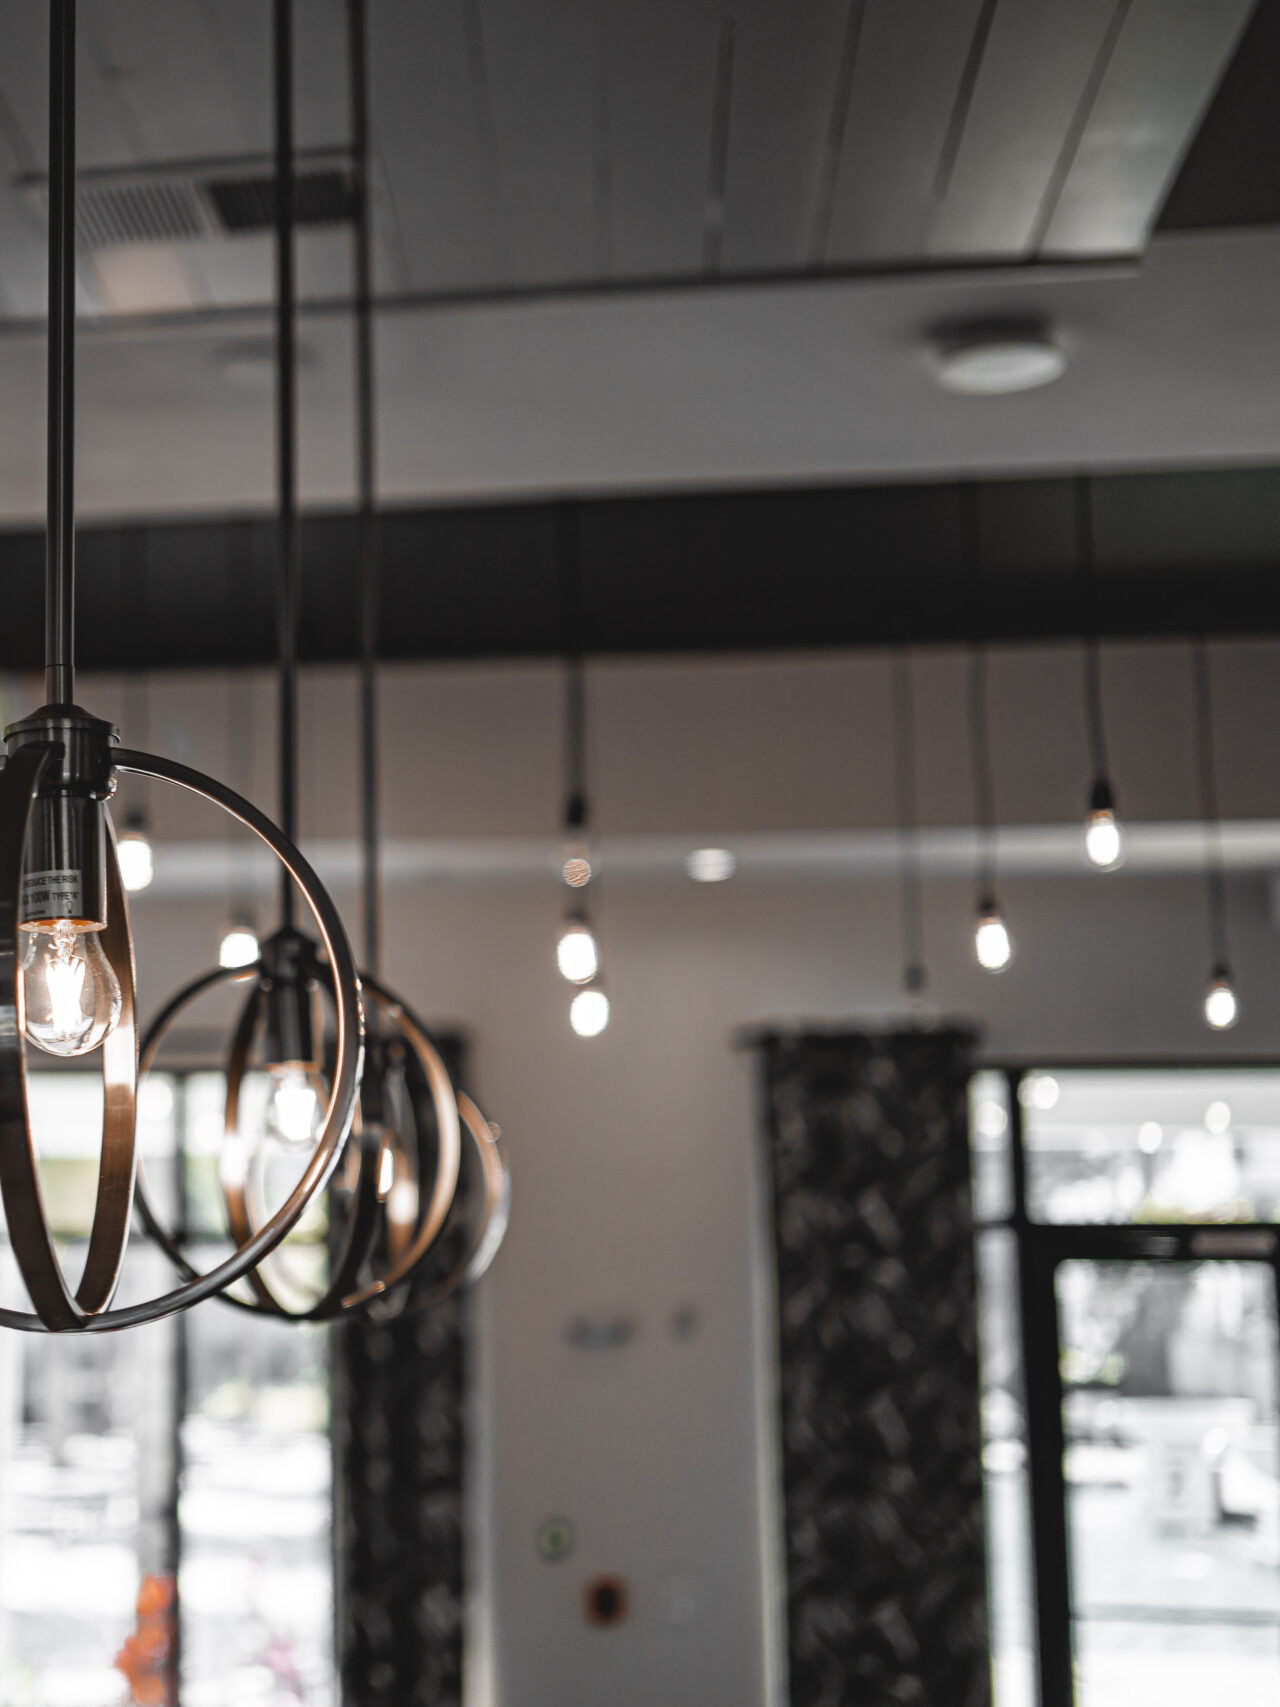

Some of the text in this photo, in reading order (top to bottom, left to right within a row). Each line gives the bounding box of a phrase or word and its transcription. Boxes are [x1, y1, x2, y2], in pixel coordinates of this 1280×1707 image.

[48, 876, 61, 884] THE
[62, 875, 79, 883] RISK
[51, 892, 70, 900] TYPE
